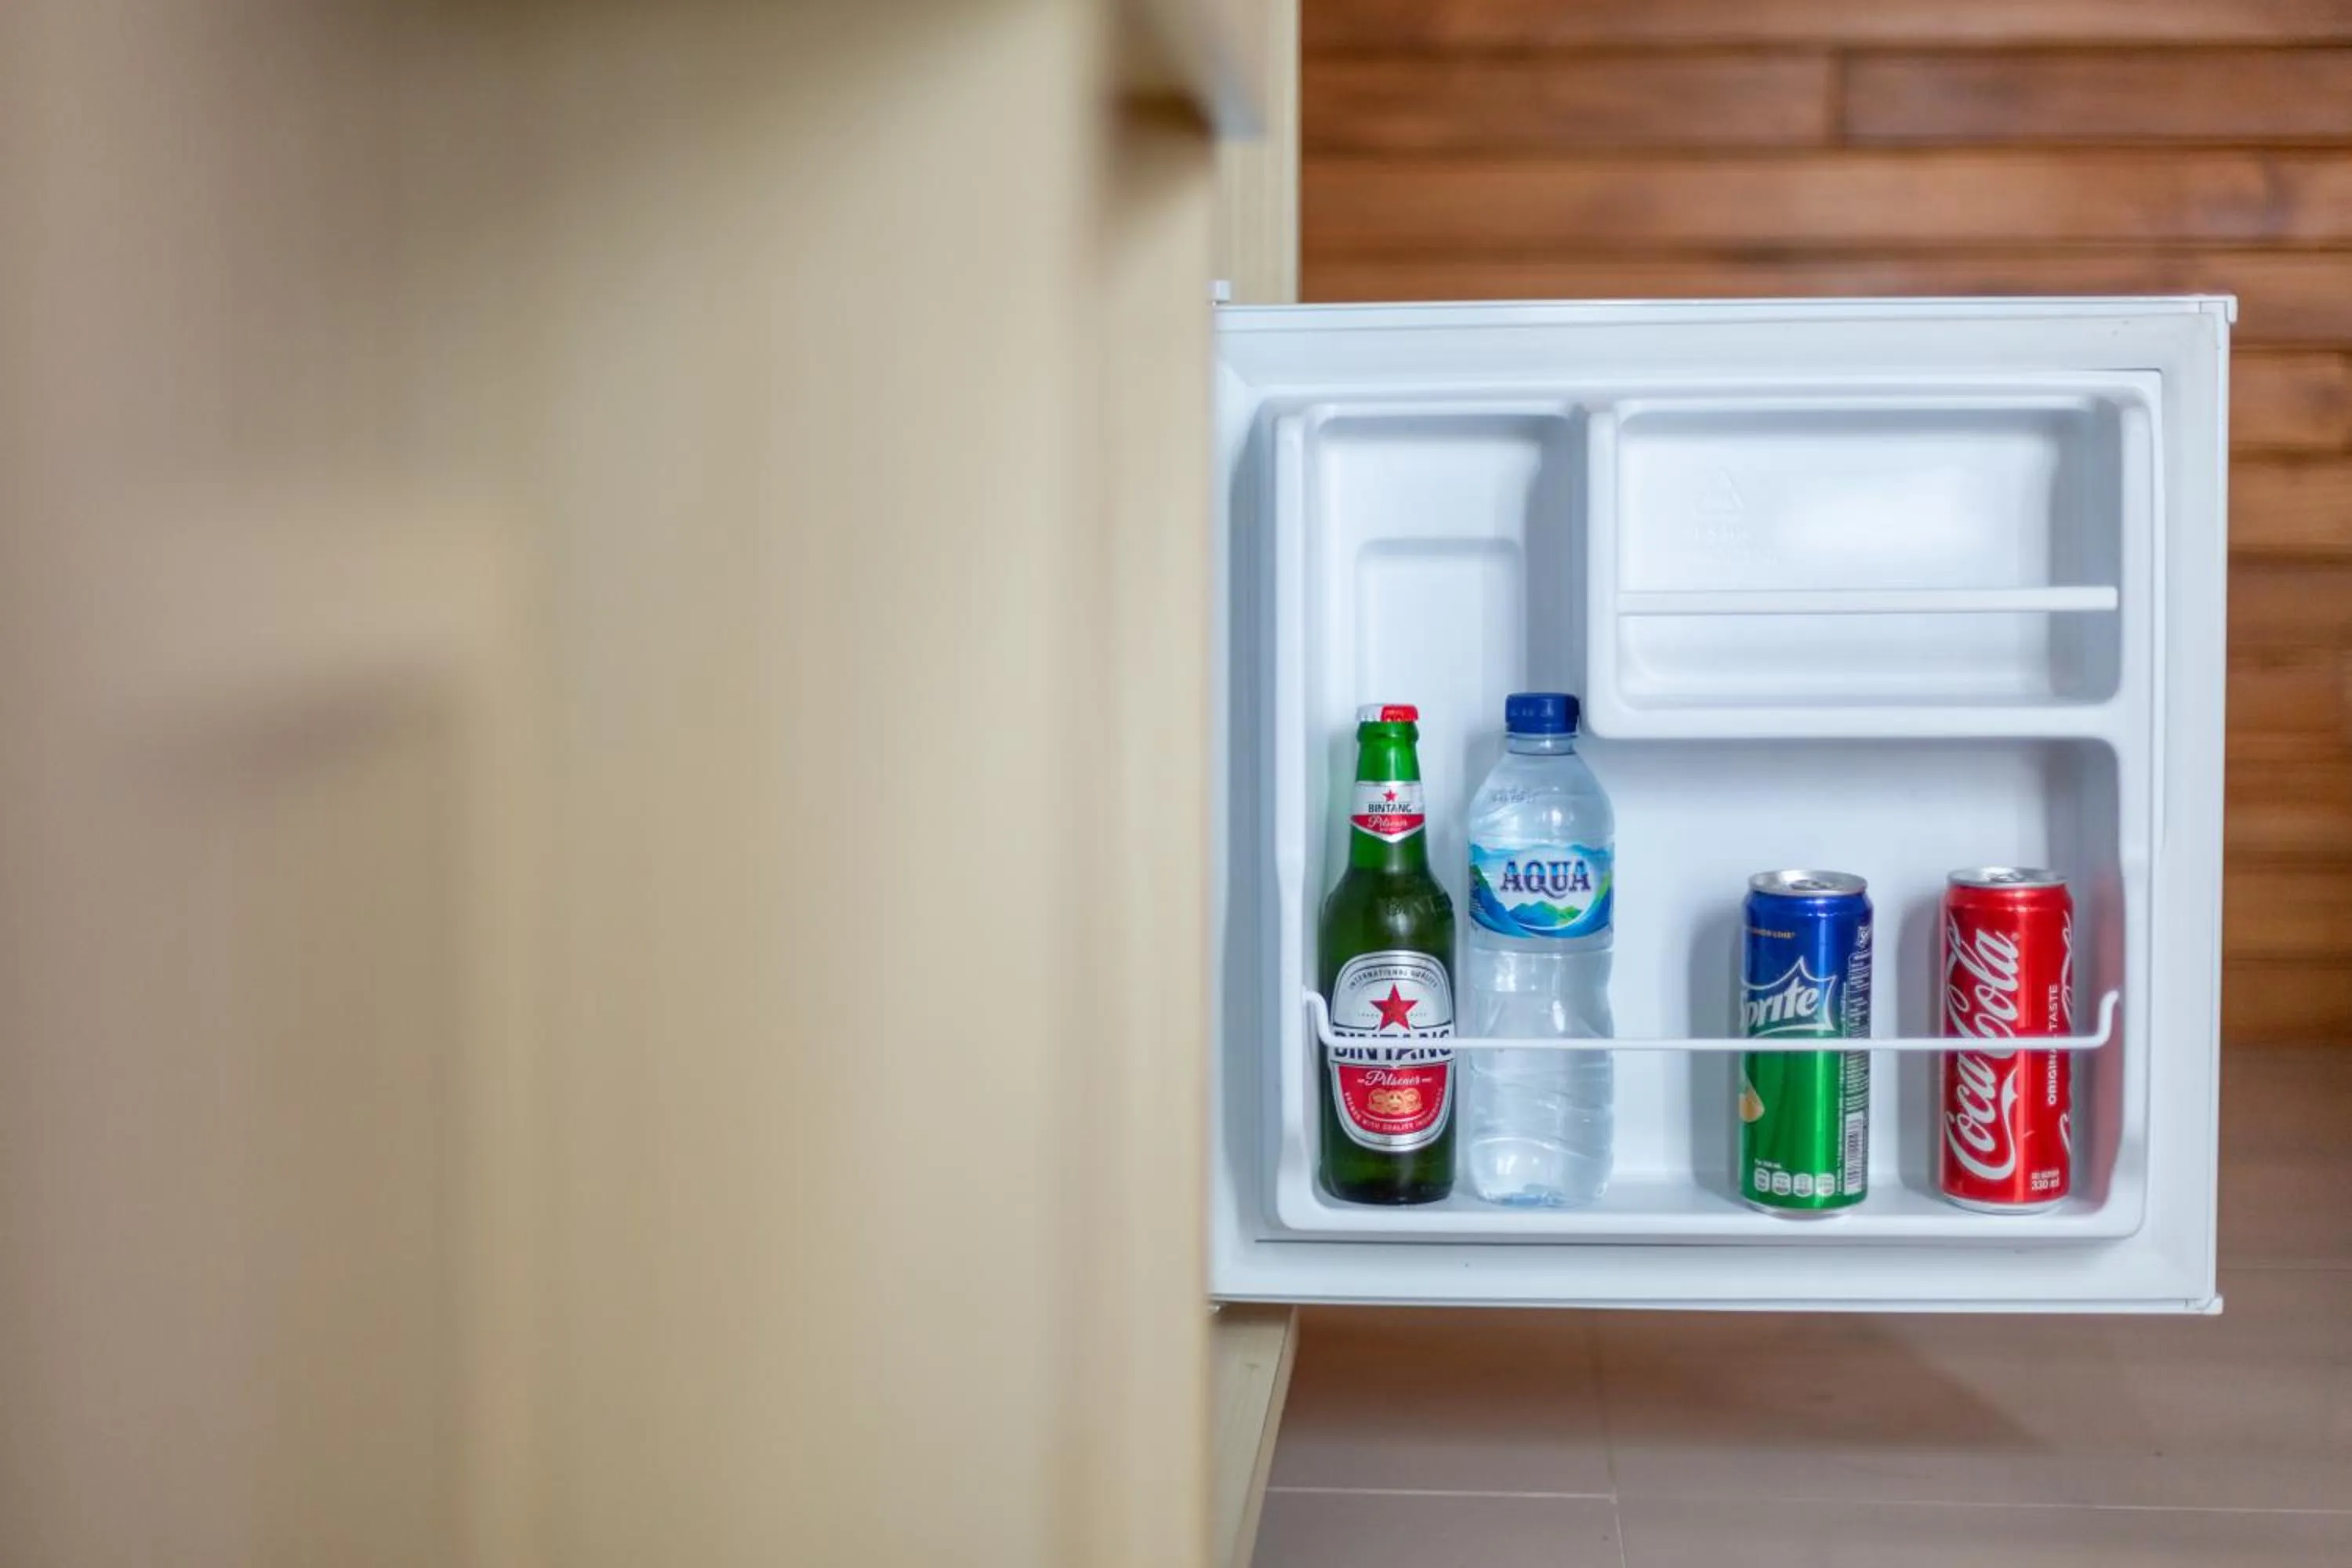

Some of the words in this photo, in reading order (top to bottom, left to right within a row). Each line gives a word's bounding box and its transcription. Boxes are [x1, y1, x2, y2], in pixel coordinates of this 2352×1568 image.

[1367, 803, 1412, 813] BINTANG
[1500, 859, 1592, 898] AQUA
[1739, 976, 1821, 1035] prite
[2047, 983, 2059, 1032] TASTE
[1333, 1029, 1451, 1061] BINTANG
[1944, 908, 2019, 1180] CocaCola
[1364, 1069, 1421, 1086] Pilsener
